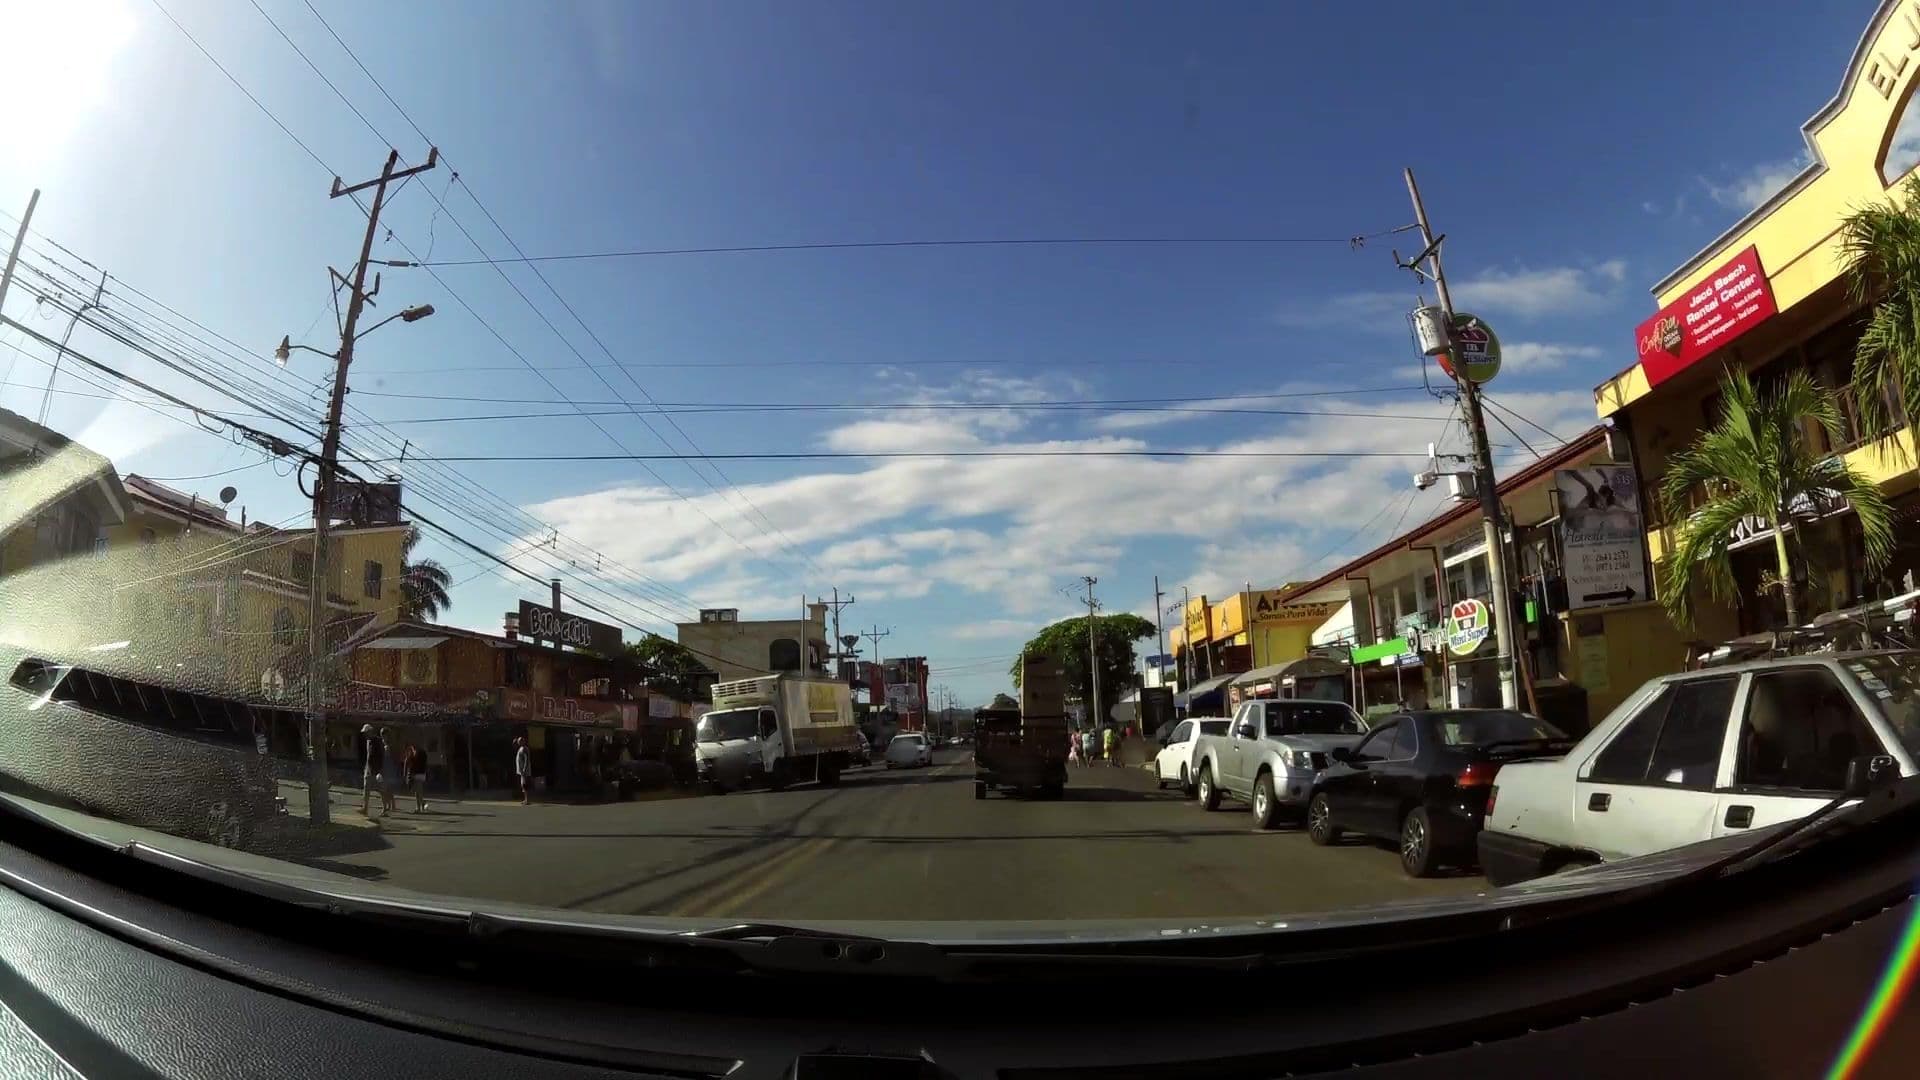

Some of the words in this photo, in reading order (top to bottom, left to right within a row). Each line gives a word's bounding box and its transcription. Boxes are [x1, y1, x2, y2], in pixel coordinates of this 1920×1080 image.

[1867, 52, 1910, 100] EL
[1686, 297, 1719, 325] Rental
[1720, 273, 1757, 302] Center
[1714, 264, 1746, 290] Beach
